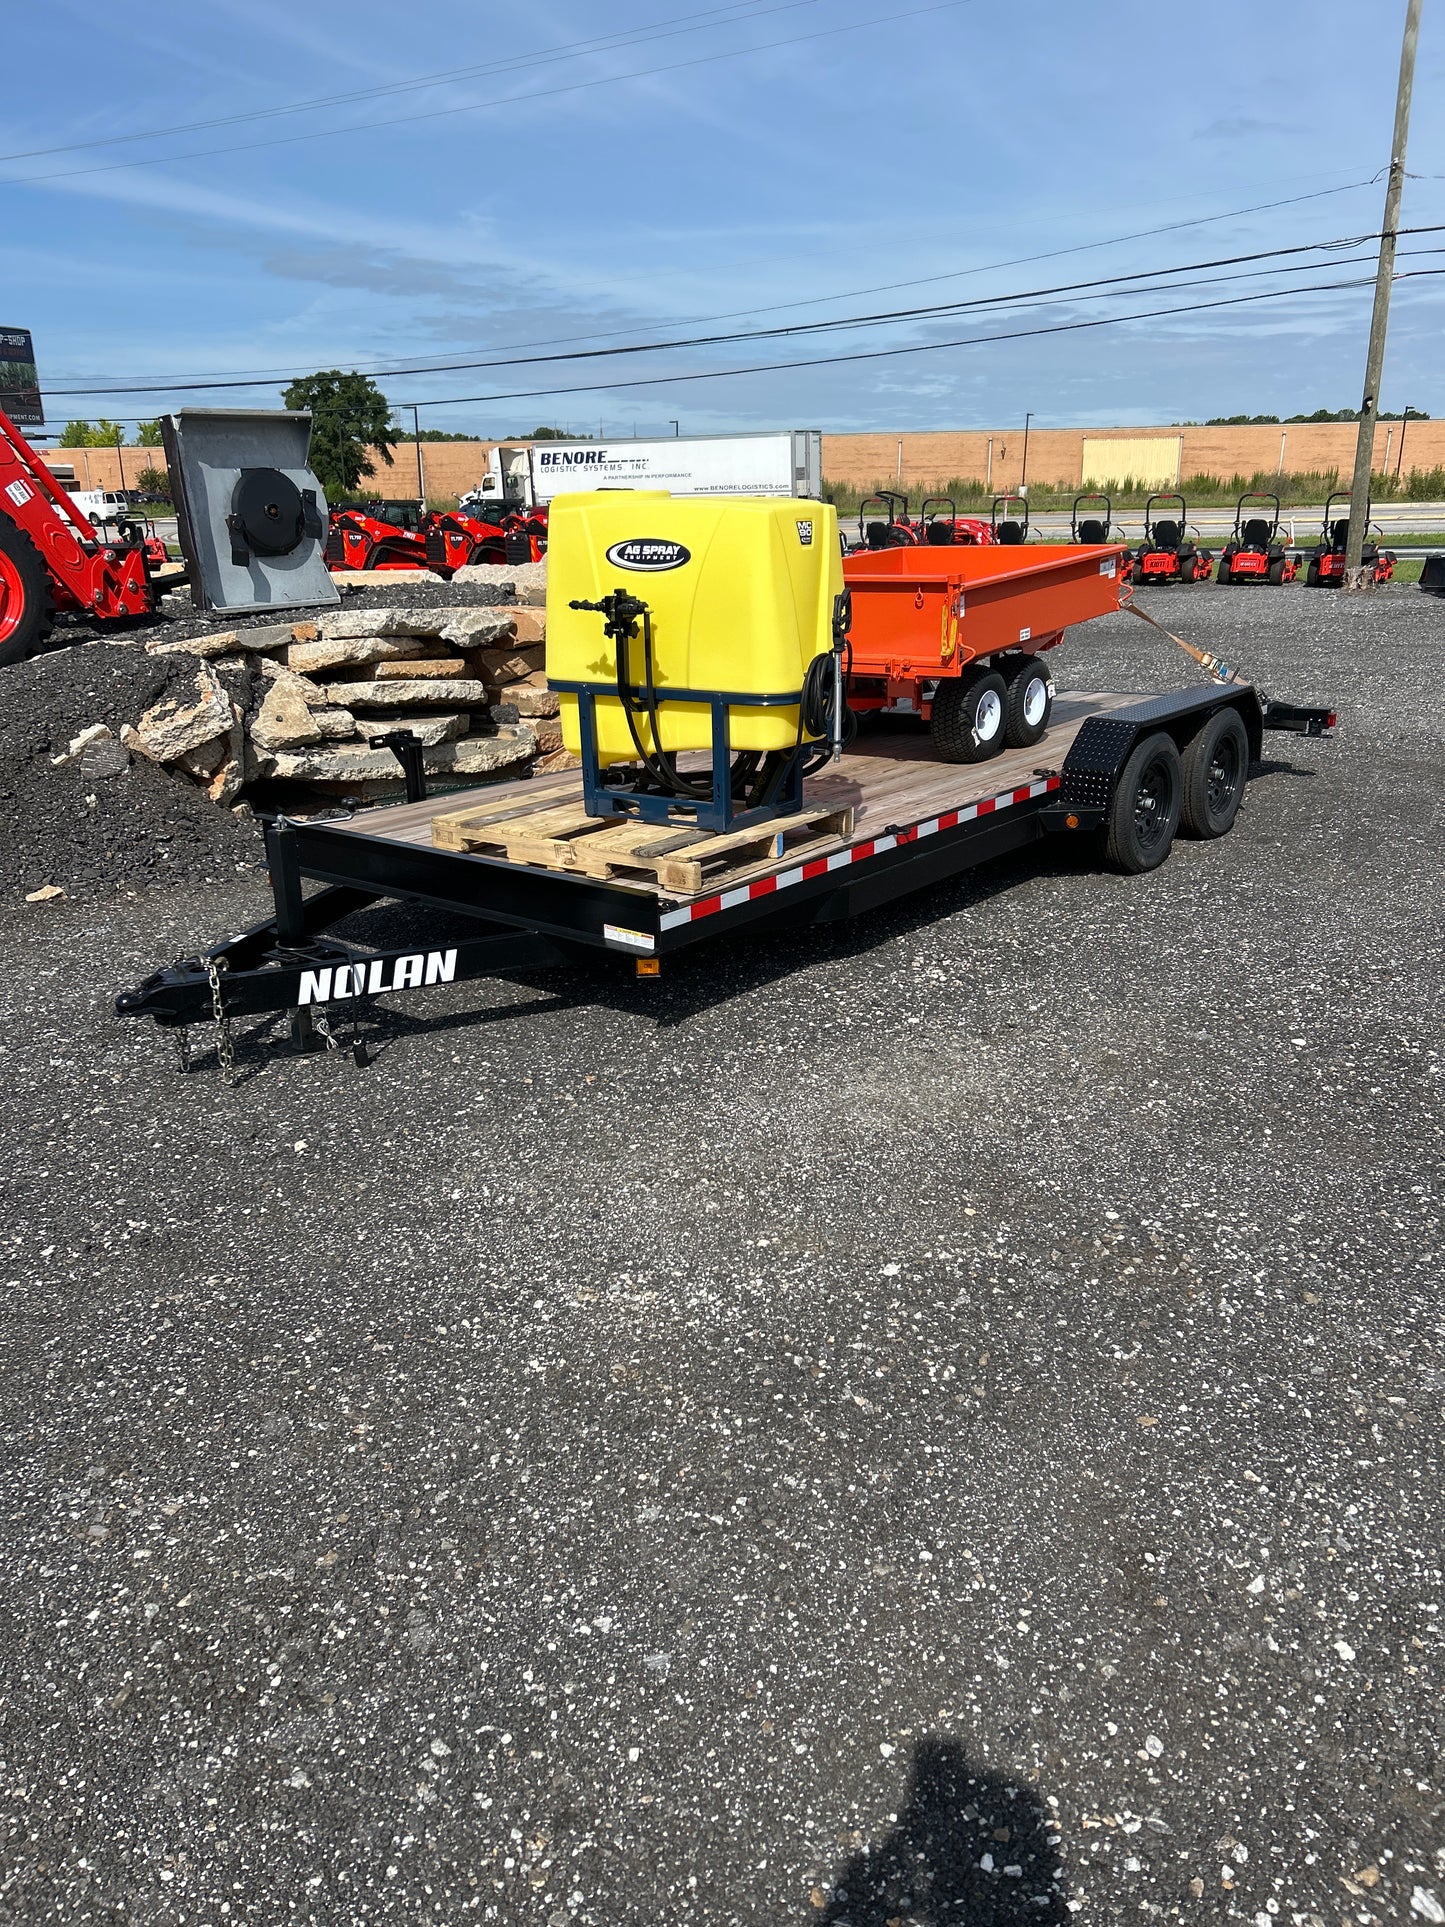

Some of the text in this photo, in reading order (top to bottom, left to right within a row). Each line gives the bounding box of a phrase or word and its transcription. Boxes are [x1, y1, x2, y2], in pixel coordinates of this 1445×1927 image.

[541, 450, 607, 465] BENORE
[540, 465, 577, 473] LOGISTIC
[797, 521, 811, 529] MC
[625, 545, 681, 554] AG SPRAY
[298, 949, 457, 1005] NOLAN
